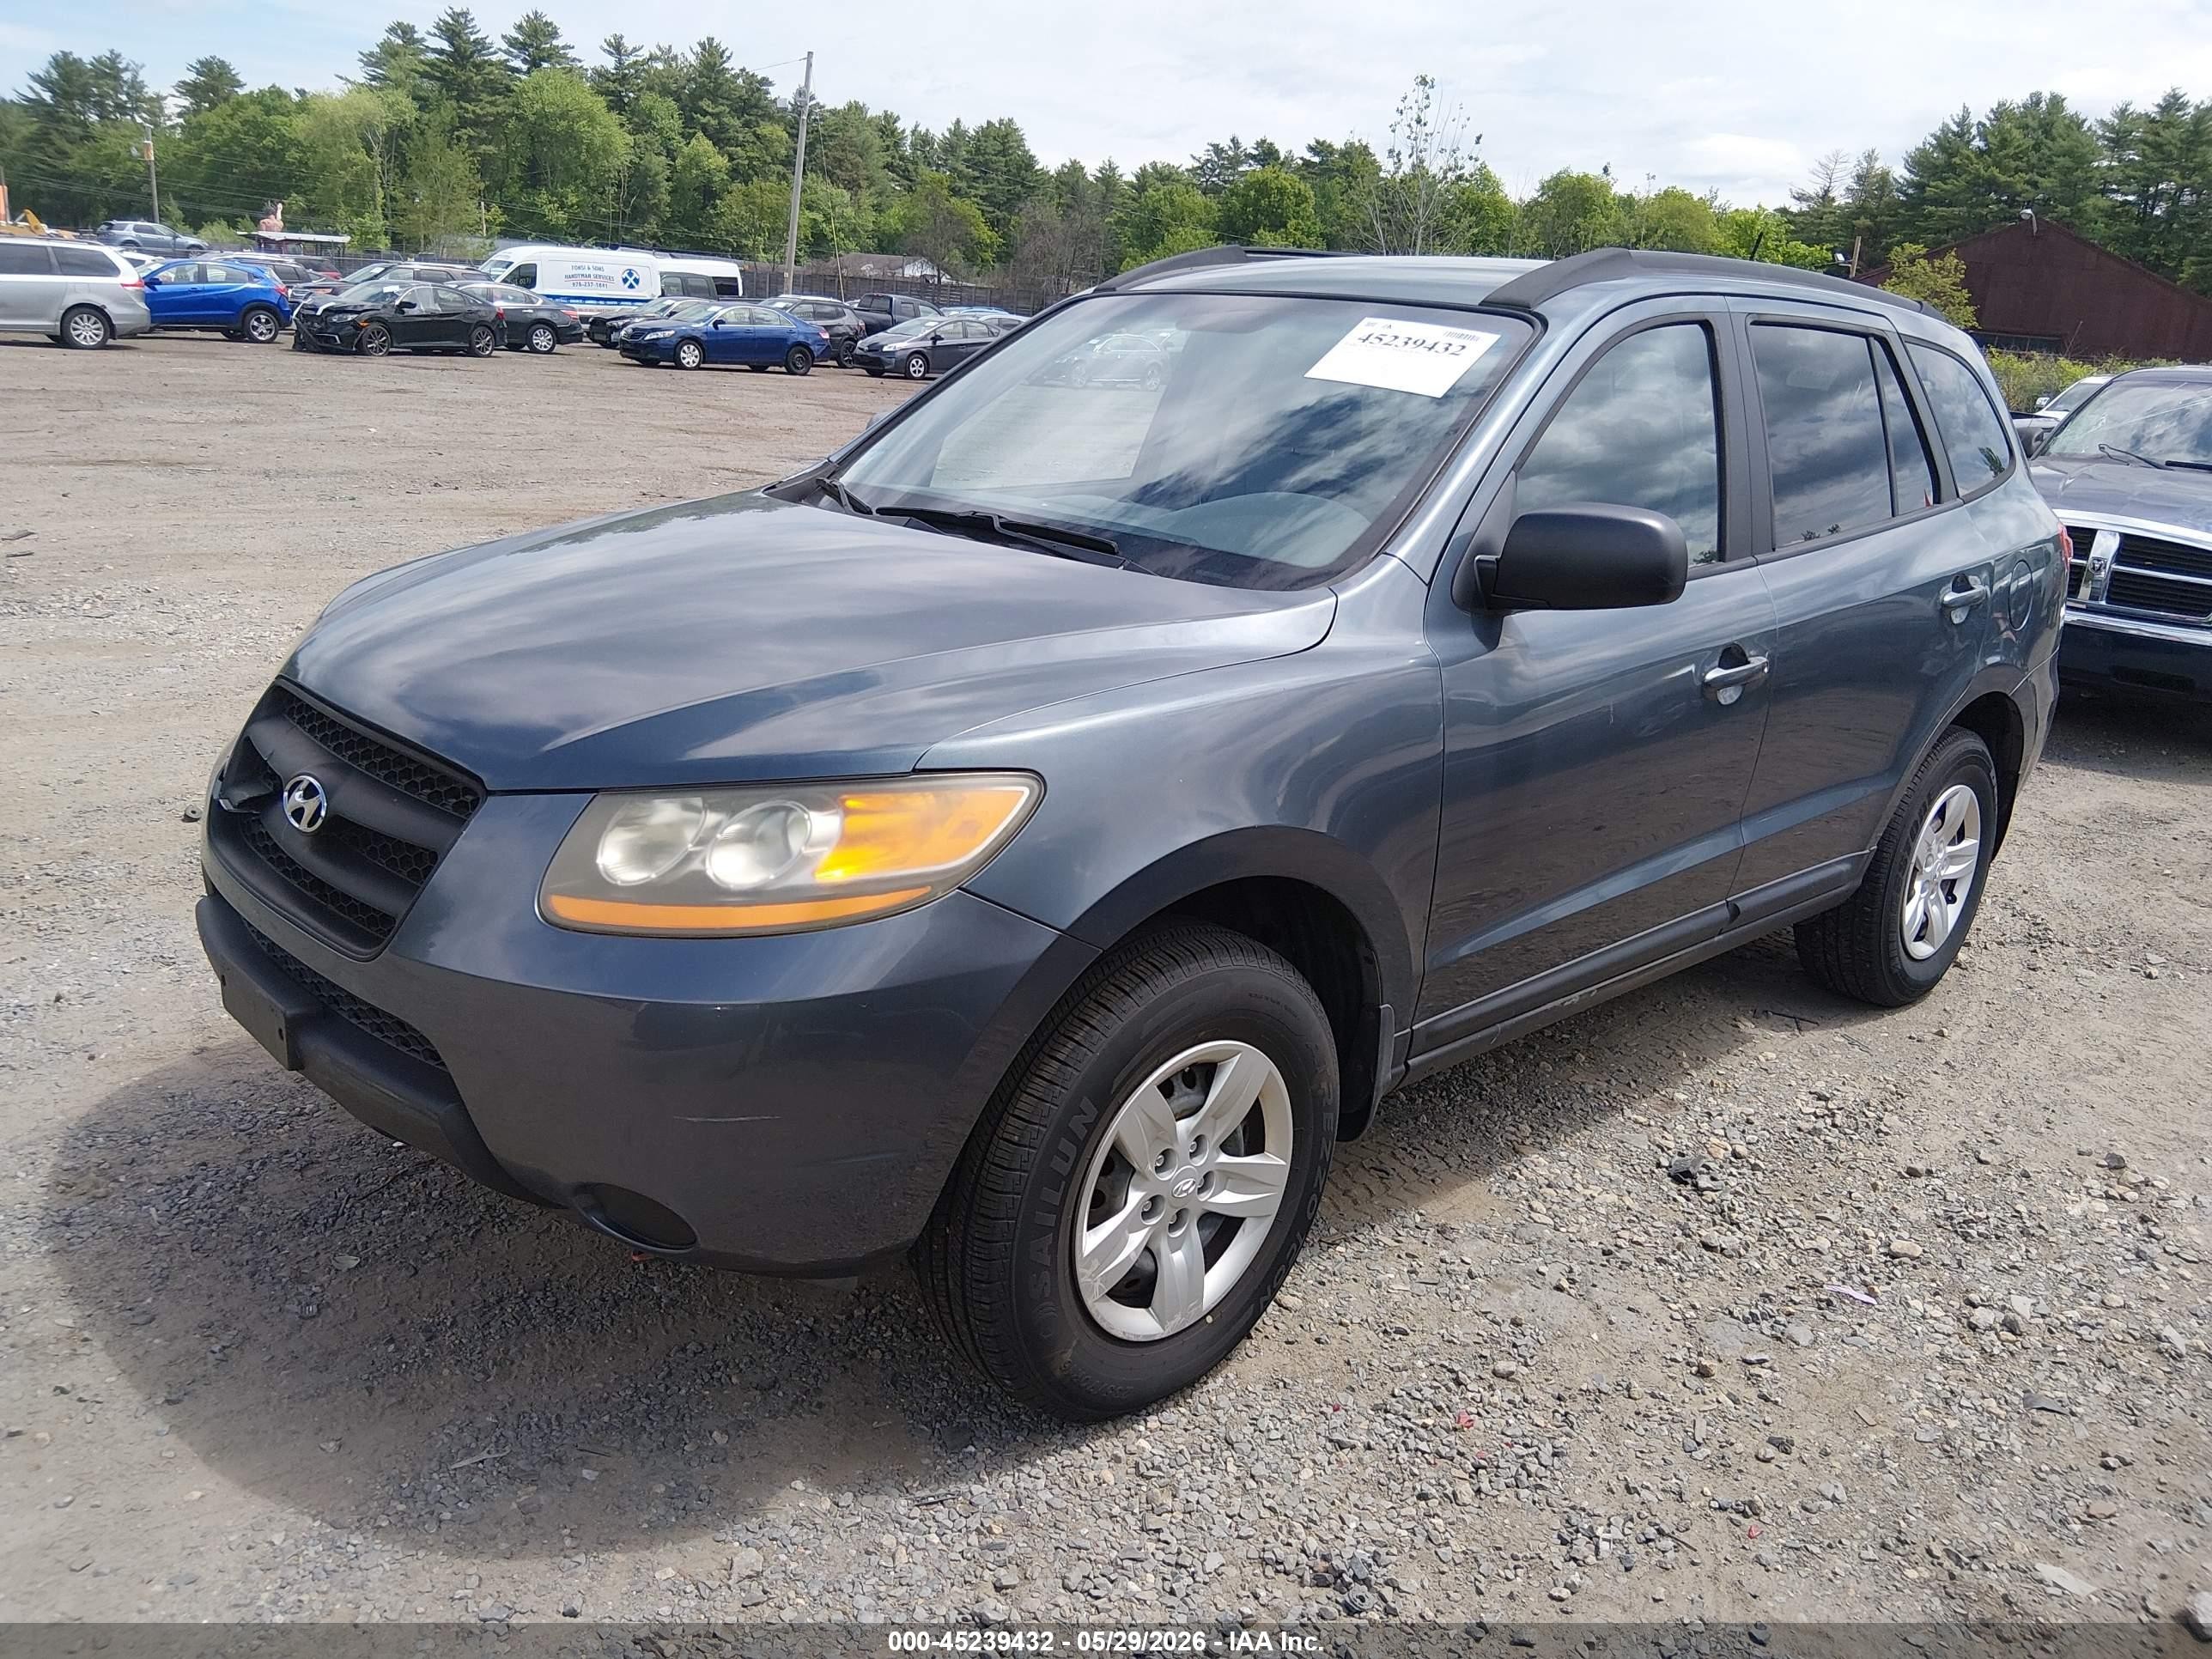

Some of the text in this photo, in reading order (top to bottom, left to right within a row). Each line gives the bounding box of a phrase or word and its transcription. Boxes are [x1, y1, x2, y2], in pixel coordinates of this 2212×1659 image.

[592, 273, 615, 282] SERVICES
[1357, 331, 1468, 356] 45239432
[1028, 1096, 1101, 1295] SAILUN
